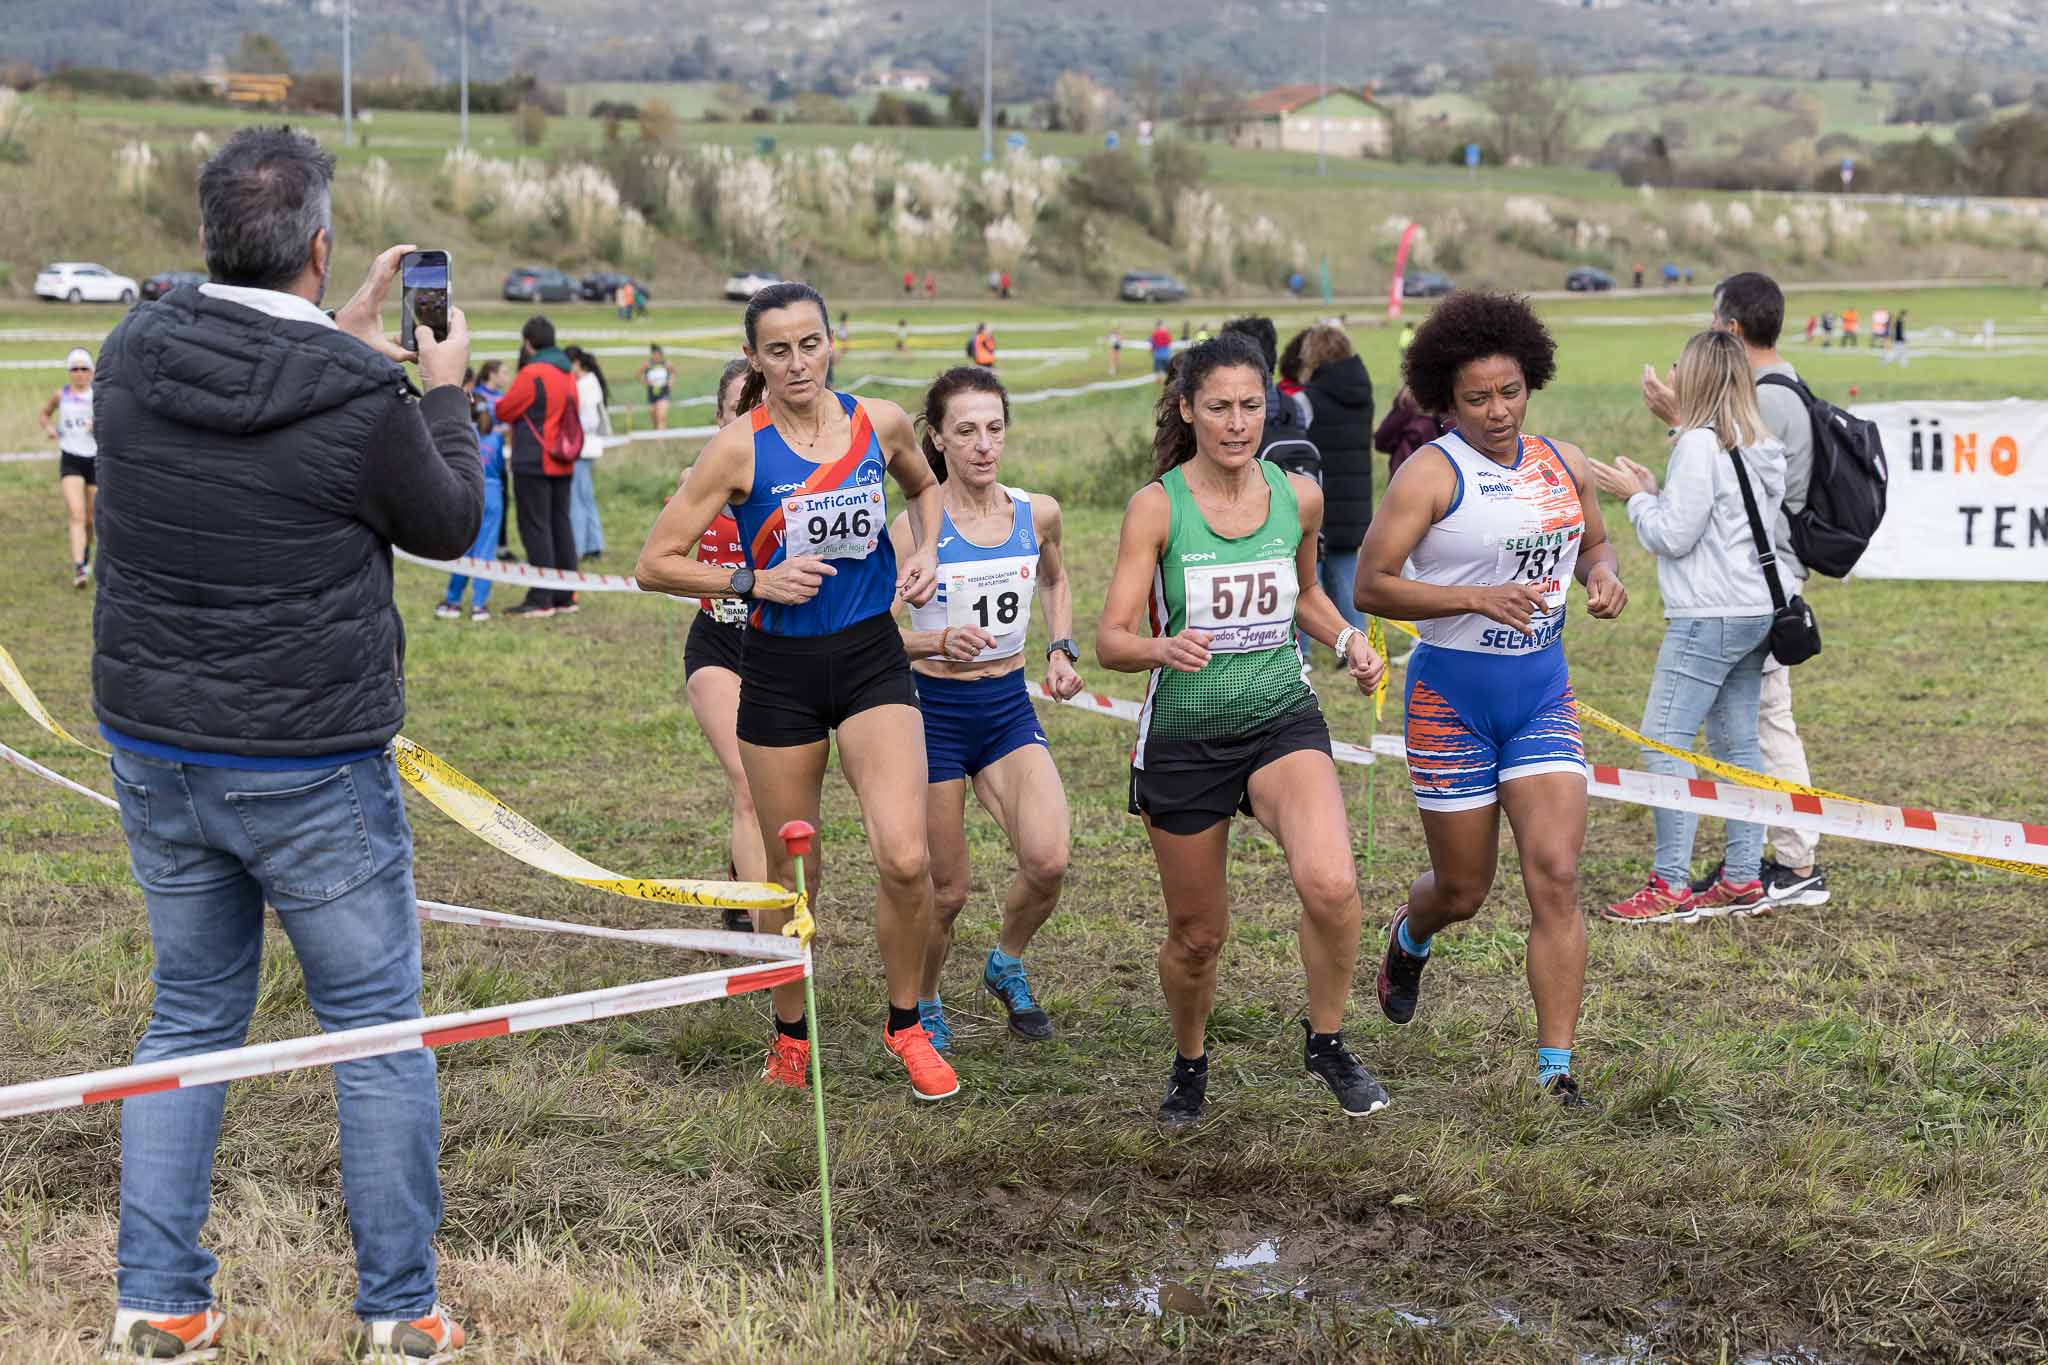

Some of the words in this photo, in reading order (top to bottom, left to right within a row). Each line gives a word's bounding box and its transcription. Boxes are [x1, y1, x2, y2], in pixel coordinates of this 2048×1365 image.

[805, 492, 869, 512] InfiCant
[807, 508, 871, 545] 946
[1505, 532, 1562, 550] SELAYA
[1512, 545, 1561, 580] 731
[972, 591, 1019, 628] 18
[1212, 571, 1278, 620] 575
[1480, 625, 1552, 649] SELAYA
